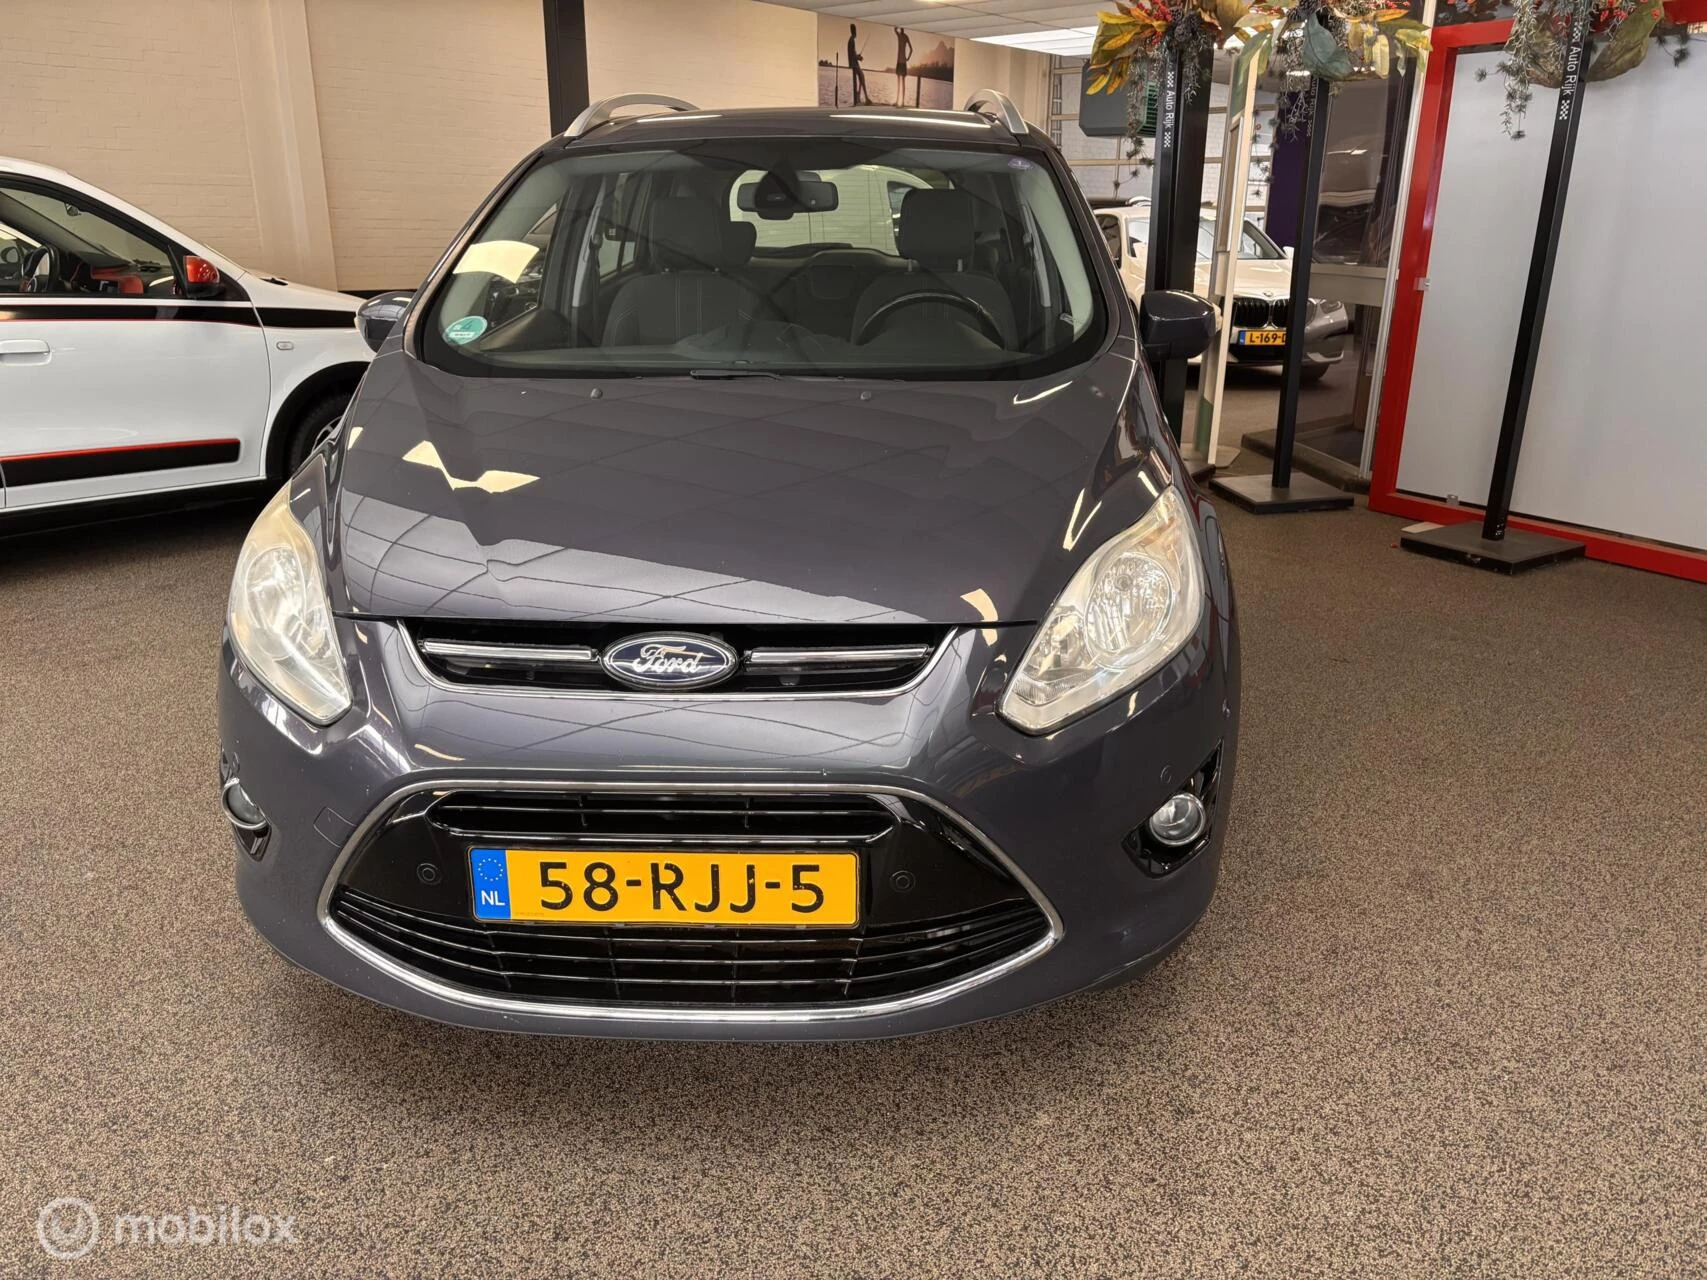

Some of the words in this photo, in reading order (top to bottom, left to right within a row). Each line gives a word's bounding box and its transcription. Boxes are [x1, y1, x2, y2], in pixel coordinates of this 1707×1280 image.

[1566, 46, 1581, 72] Auto
[1561, 75, 1577, 96] Rijk
[1165, 90, 1176, 110] Auto
[1163, 112, 1175, 129] Rijk
[632, 643, 716, 673] Ford
[481, 890, 505, 906] NL
[539, 861, 825, 914] 58-RJJ-5
